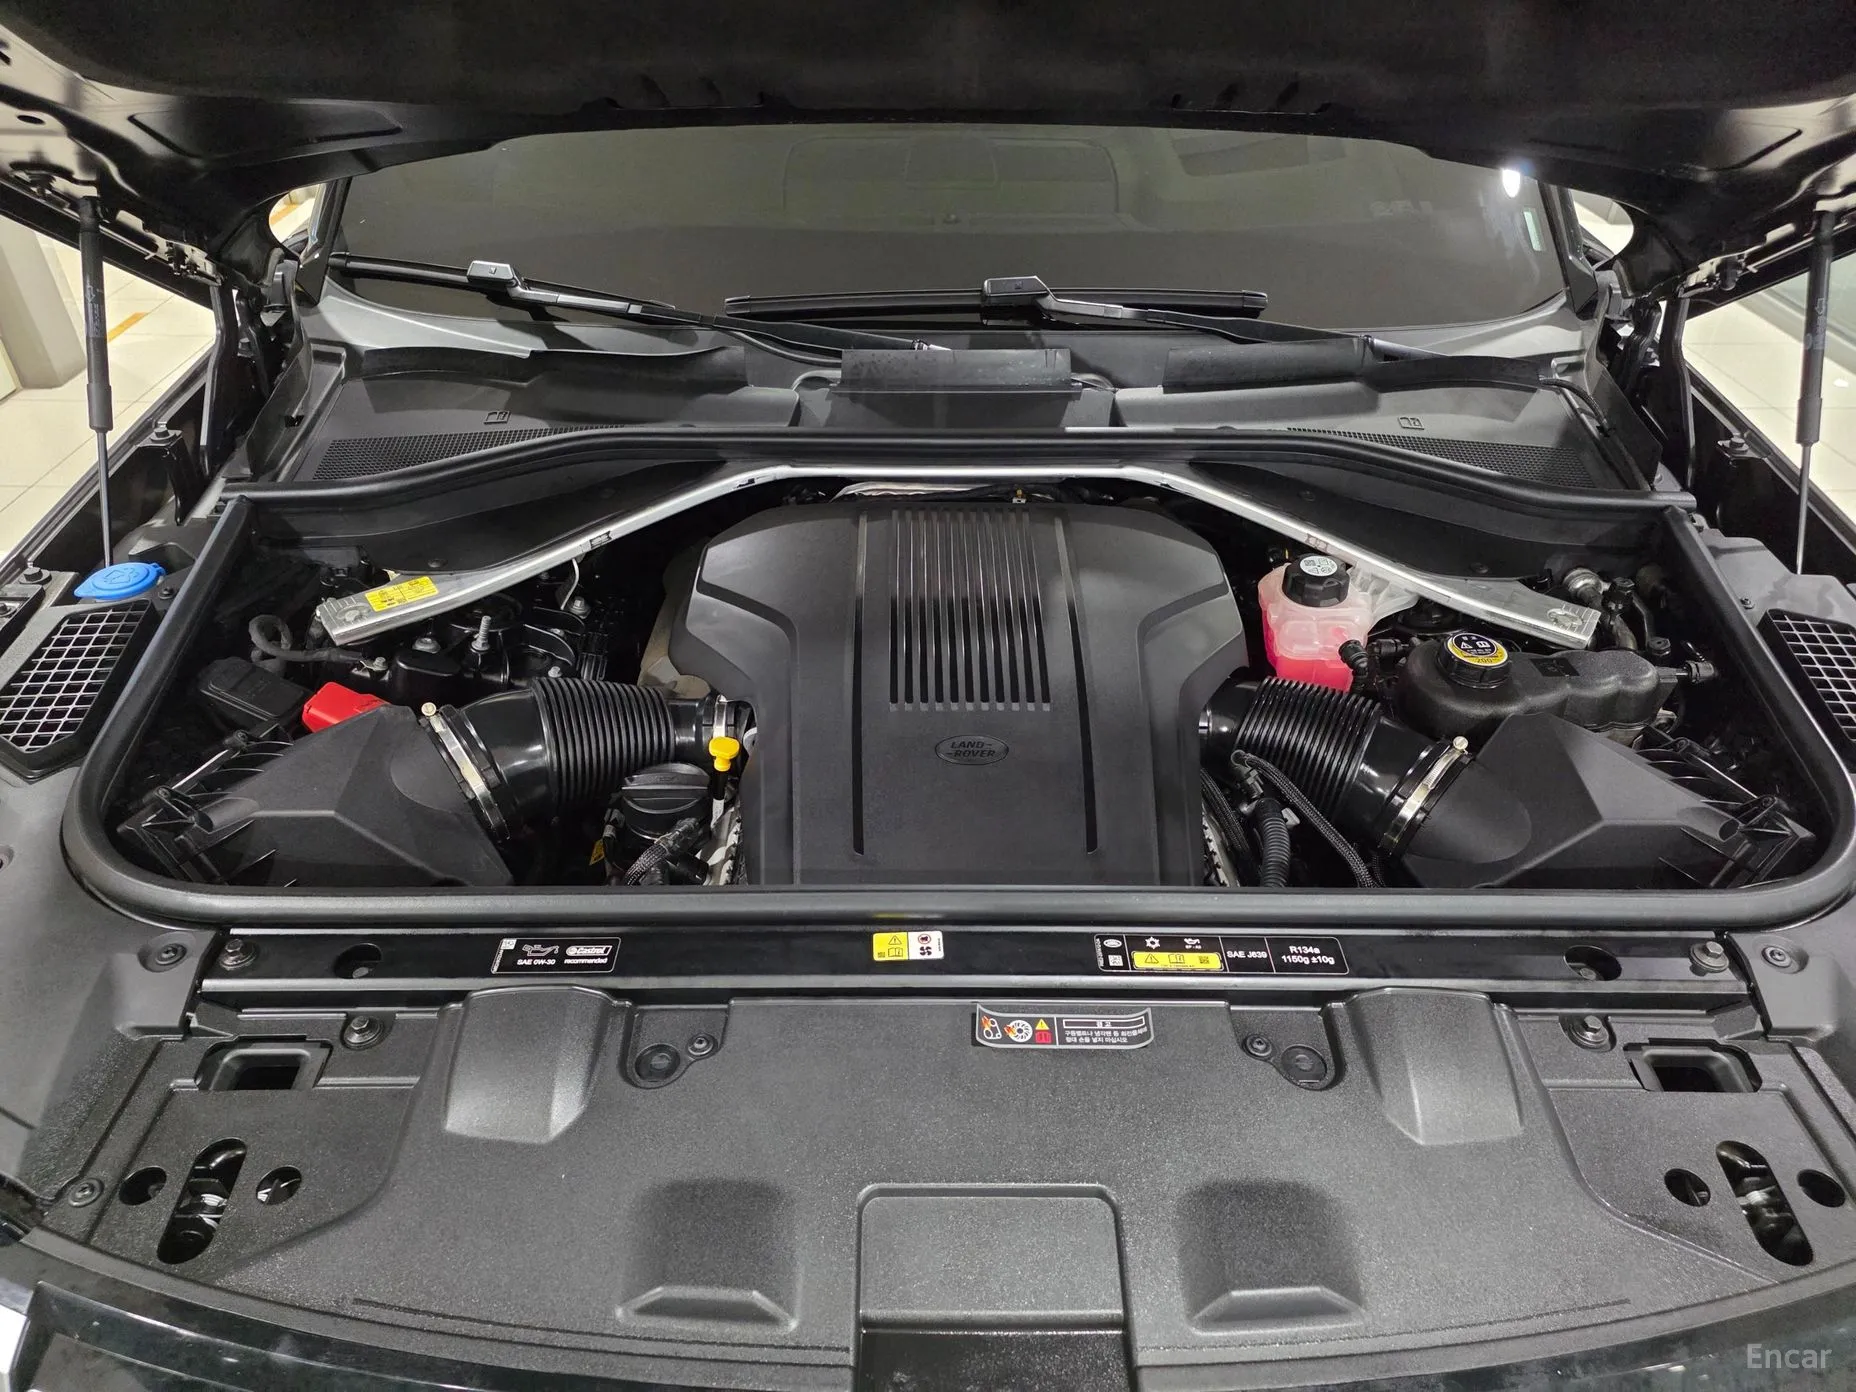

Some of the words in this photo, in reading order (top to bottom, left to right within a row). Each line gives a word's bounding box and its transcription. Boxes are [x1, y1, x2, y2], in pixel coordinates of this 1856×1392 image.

[576, 946, 605, 955] Castrol
[1289, 945, 1321, 954] R134a
[1226, 951, 1246, 959] SAE
[1281, 955, 1310, 965] 1150g
